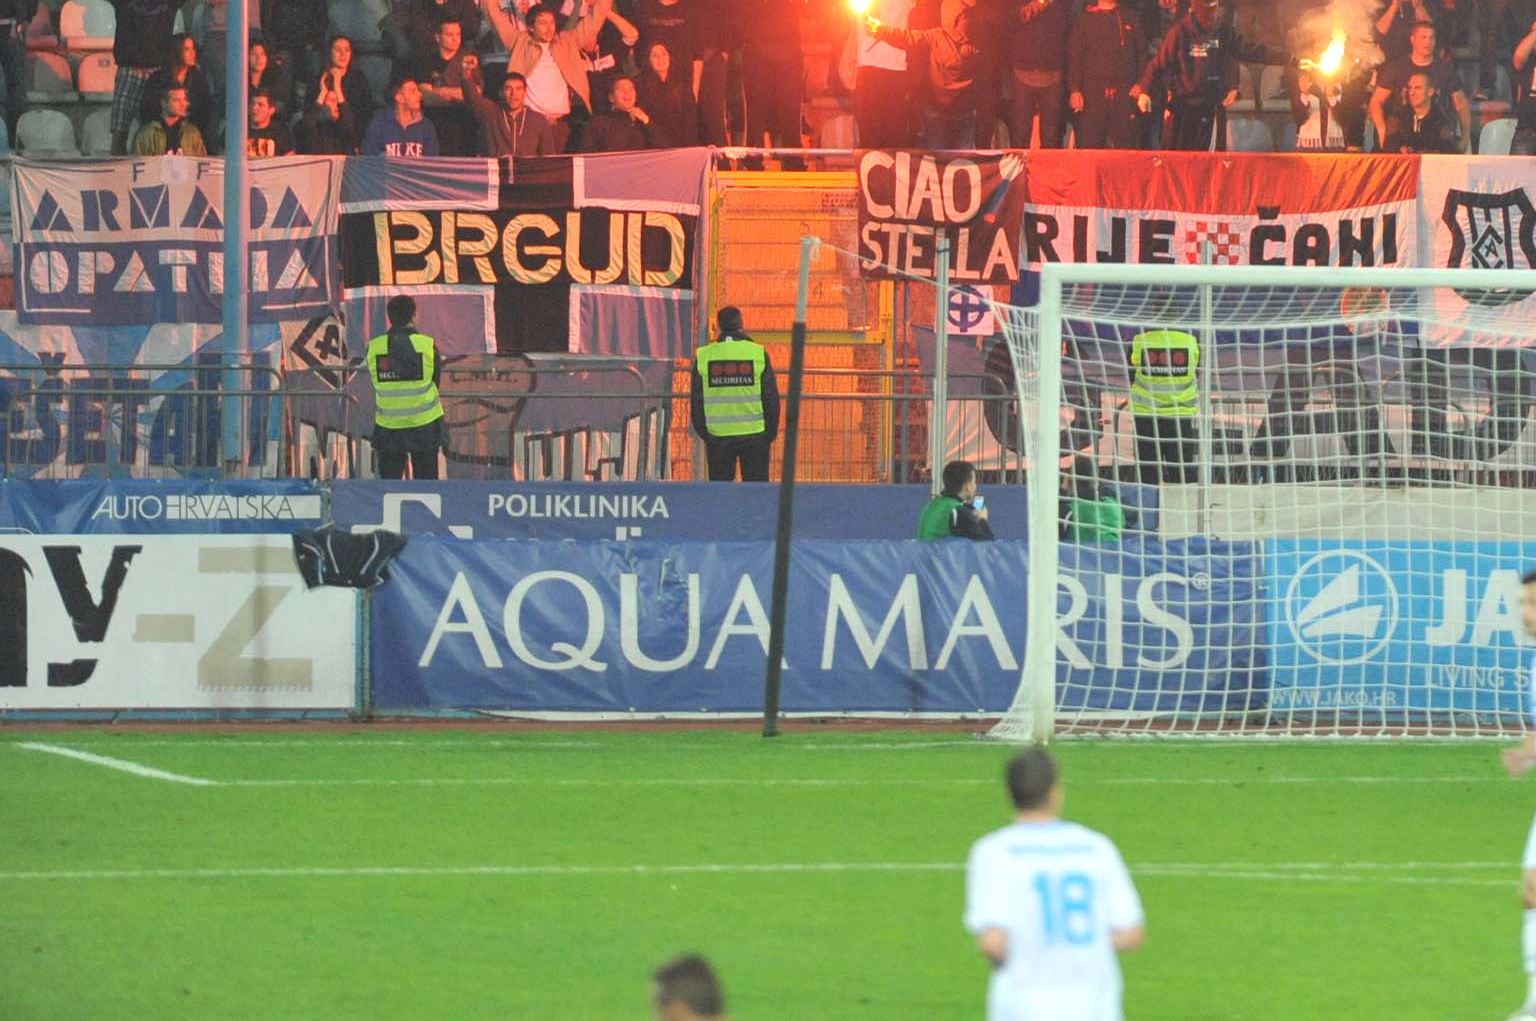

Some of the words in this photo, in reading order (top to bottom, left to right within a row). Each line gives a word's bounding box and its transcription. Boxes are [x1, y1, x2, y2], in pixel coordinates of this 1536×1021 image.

[859, 151, 982, 224] CIAO
[373, 211, 686, 287] BRGUD
[91, 495, 163, 520] AUTO
[167, 495, 297, 519] HRVATSKA
[488, 493, 670, 519] POLIKLINIKA
[418, 569, 788, 673] AQUA
[1272, 689, 1398, 707] WWW.JAKO.HR
[1426, 666, 1505, 689] LIVING
[1032, 872, 1094, 945] 18
